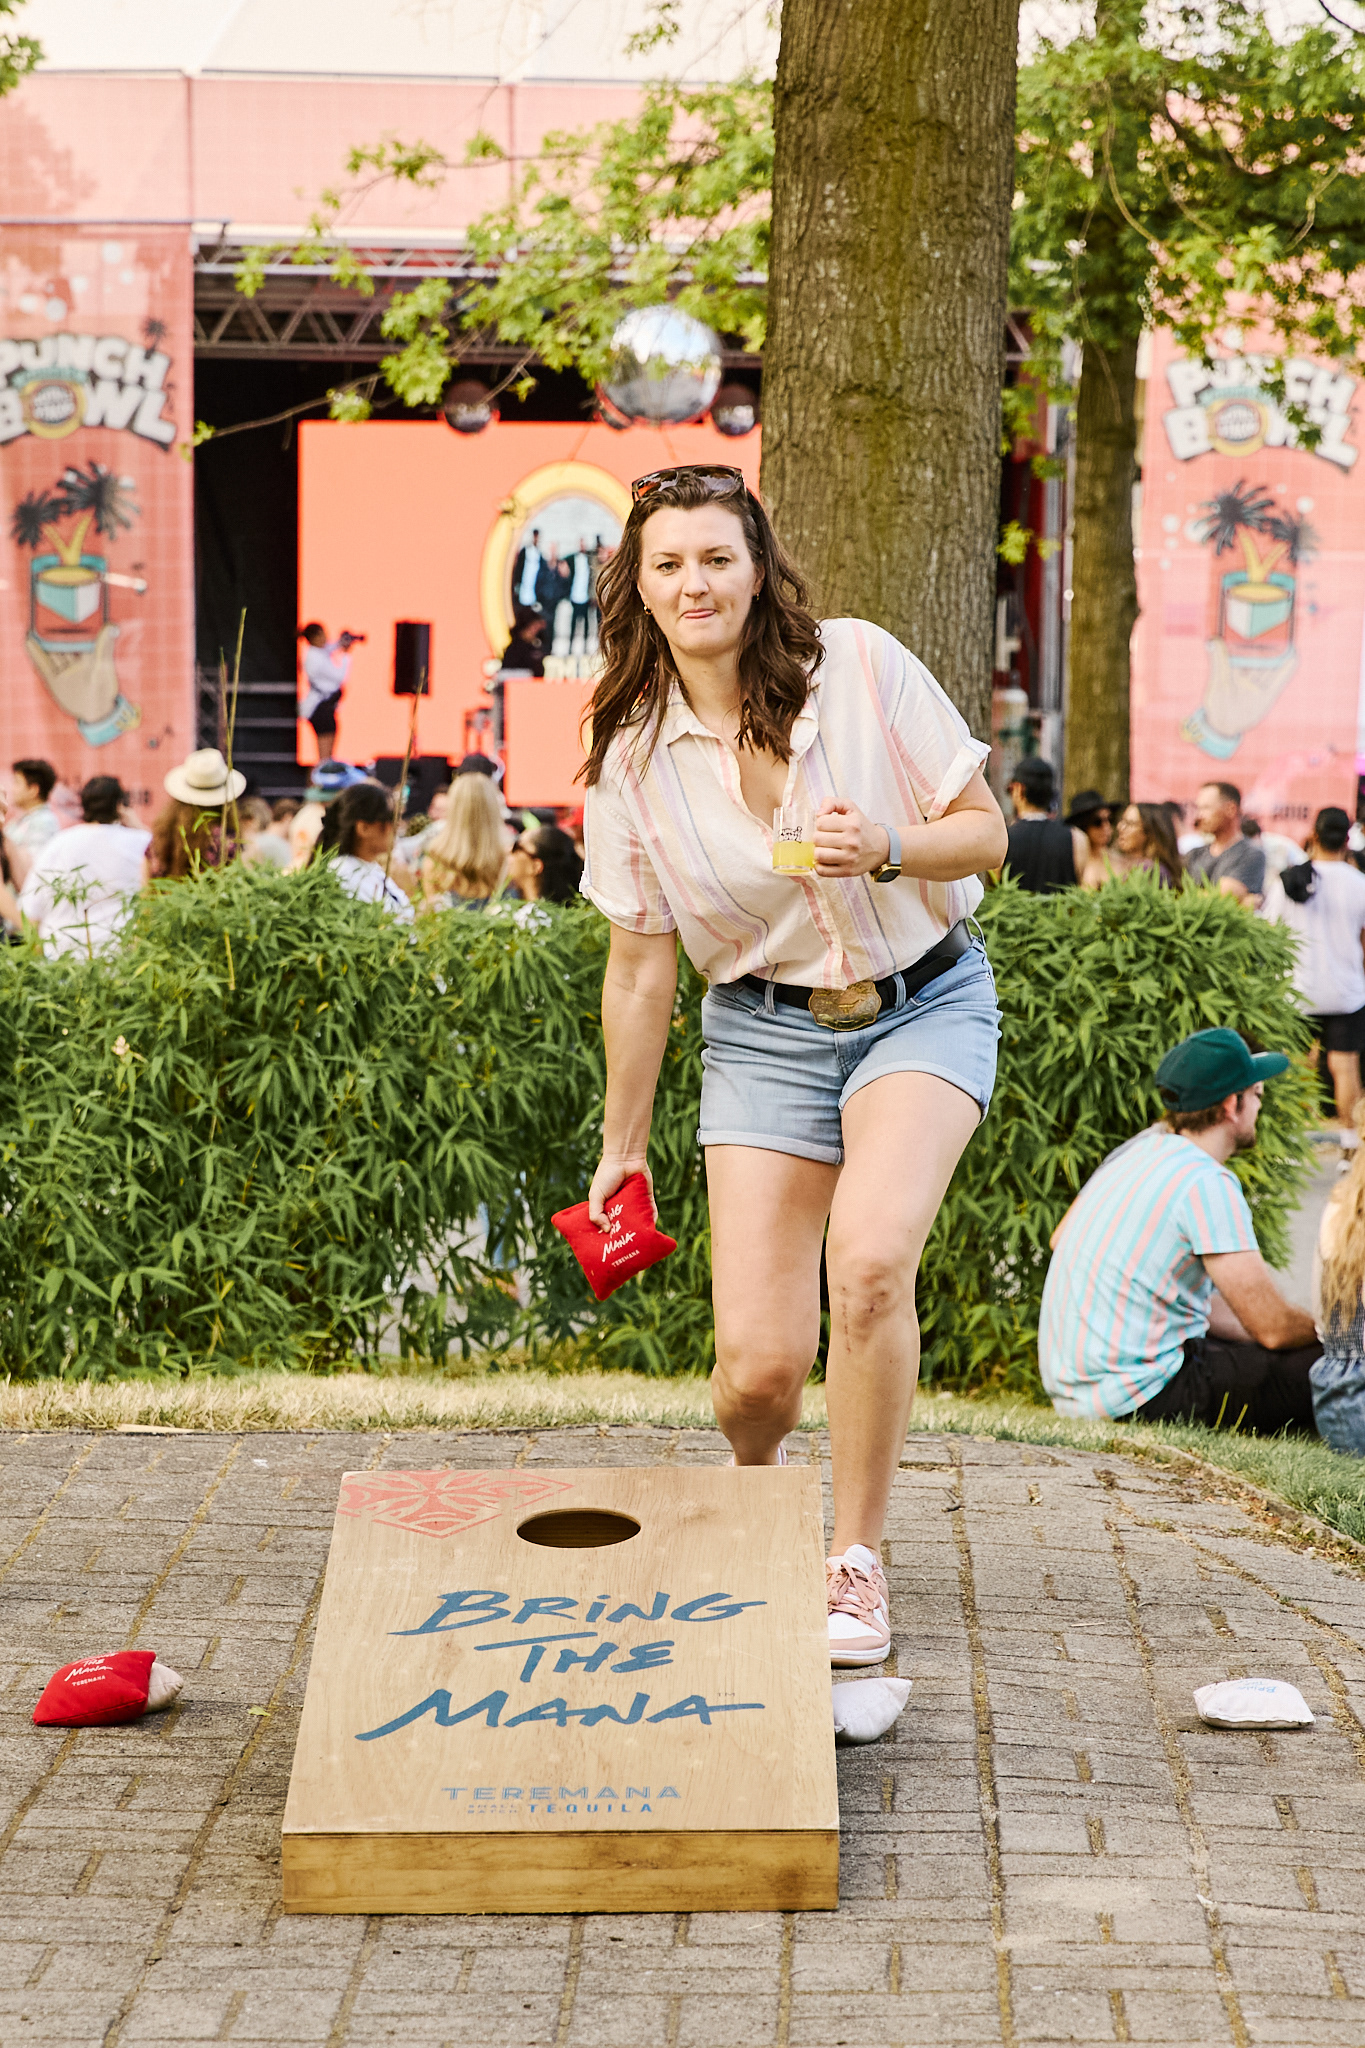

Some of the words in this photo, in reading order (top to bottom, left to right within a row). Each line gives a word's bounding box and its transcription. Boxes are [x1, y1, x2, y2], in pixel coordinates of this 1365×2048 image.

[602, 1231, 637, 1263] MANA
[611, 1249, 641, 1268] TEREMANA
[81, 1658, 106, 1668] THE
[474, 1631, 675, 1684] THE
[64, 1665, 114, 1682] MANA
[72, 1675, 106, 1687] TEREMANA
[354, 1688, 766, 1741] MANA
[441, 1786, 682, 1801] TEREMANA
[528, 1803, 653, 1814] TEQUILA
